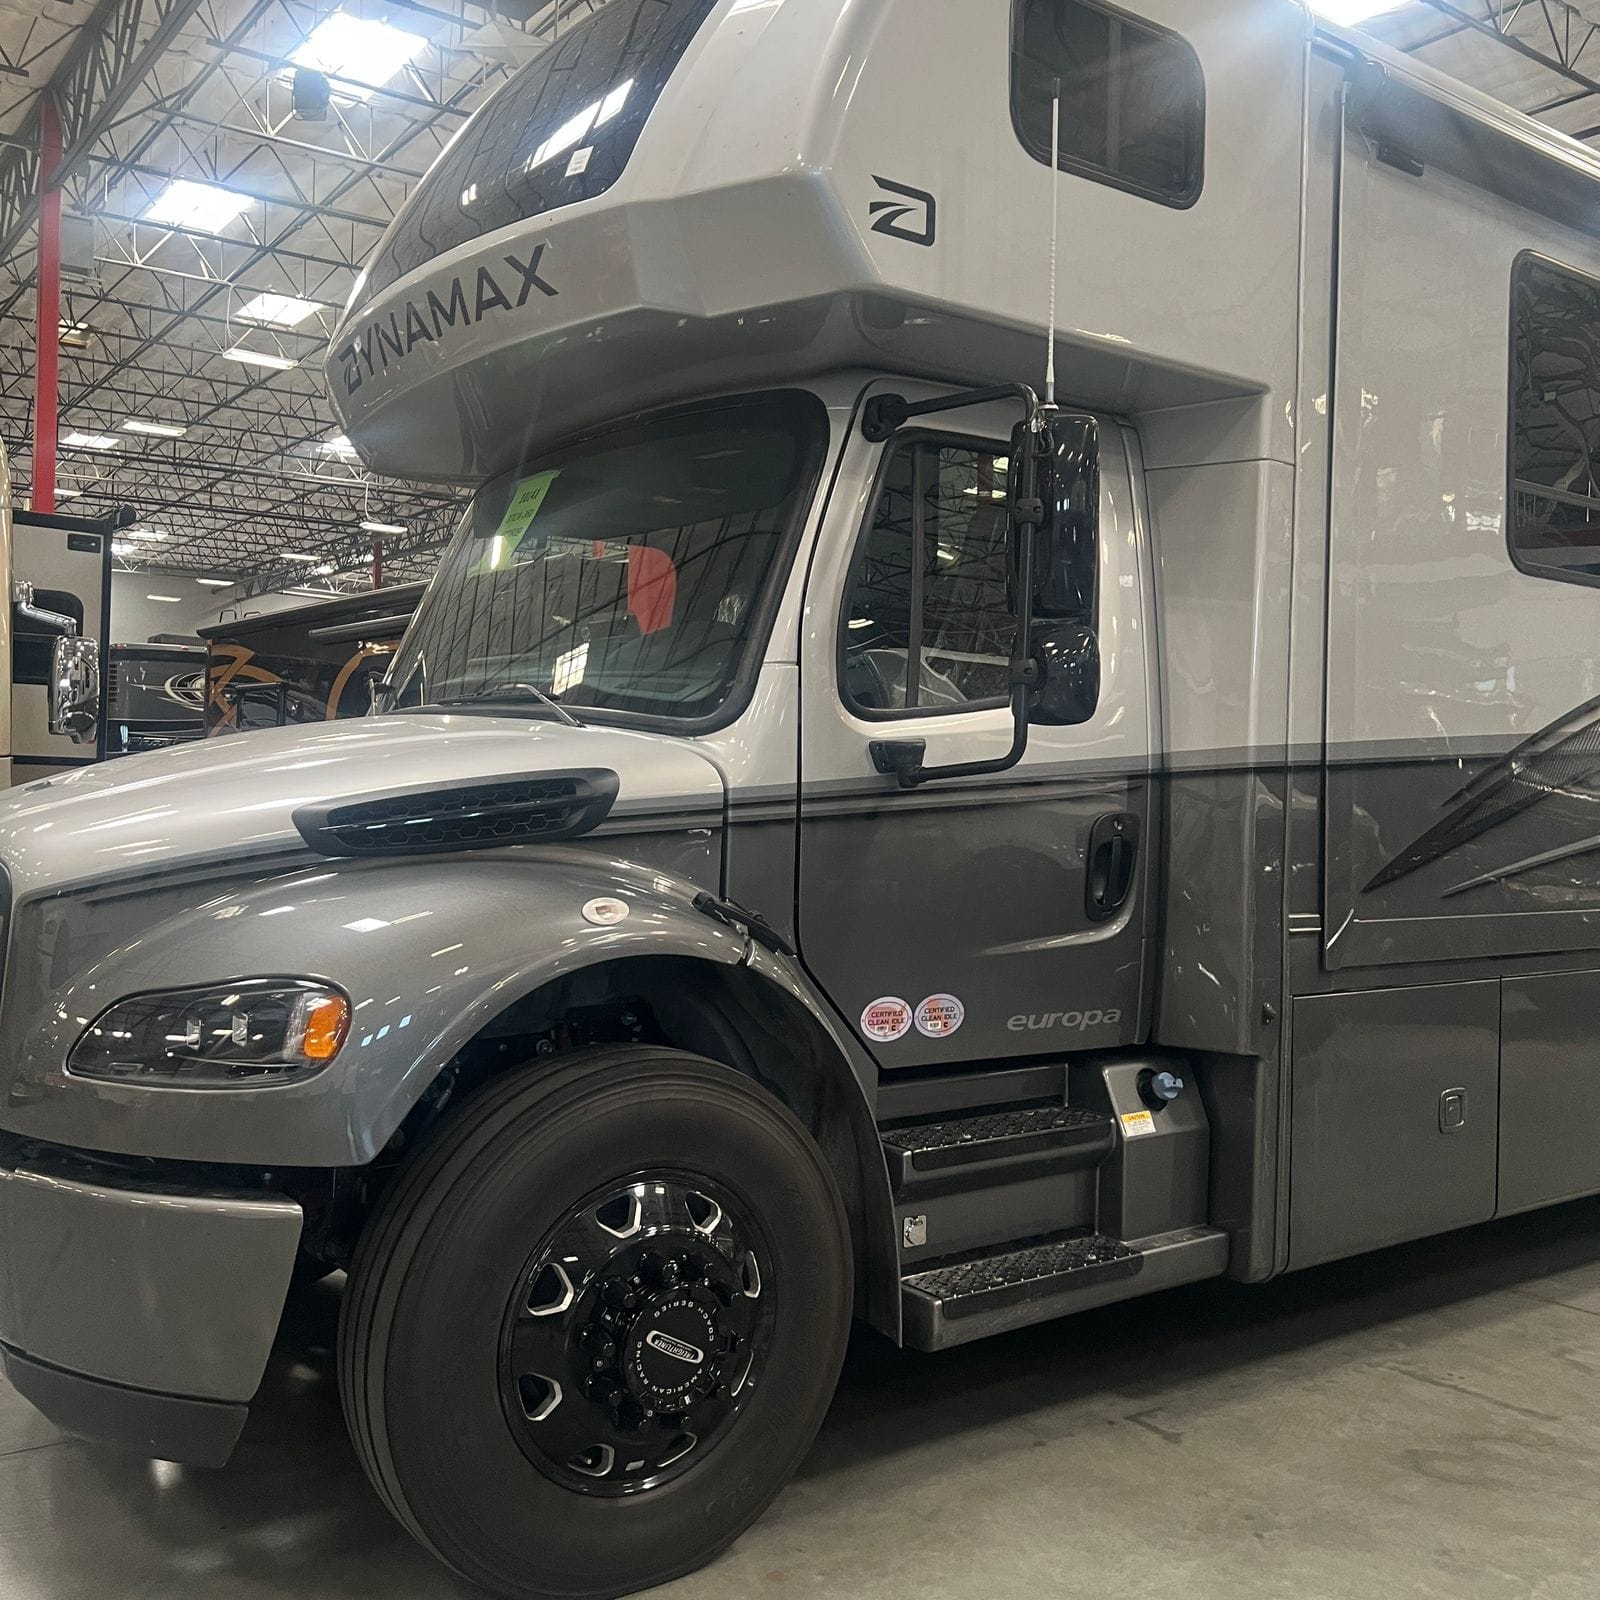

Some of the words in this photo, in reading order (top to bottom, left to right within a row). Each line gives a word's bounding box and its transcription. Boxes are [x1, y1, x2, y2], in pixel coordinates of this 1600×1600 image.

[338, 243, 559, 395] DYNAMAX
[871, 1010, 903, 1018] CERTIFIED
[924, 1006, 955, 1014] CERTIFIED
[1007, 1008, 1121, 1031] europa
[654, 1338, 695, 1360] FREIGHTLINER
[635, 1341, 649, 1385] RACING
[652, 1368, 703, 1395] AMERICAN
